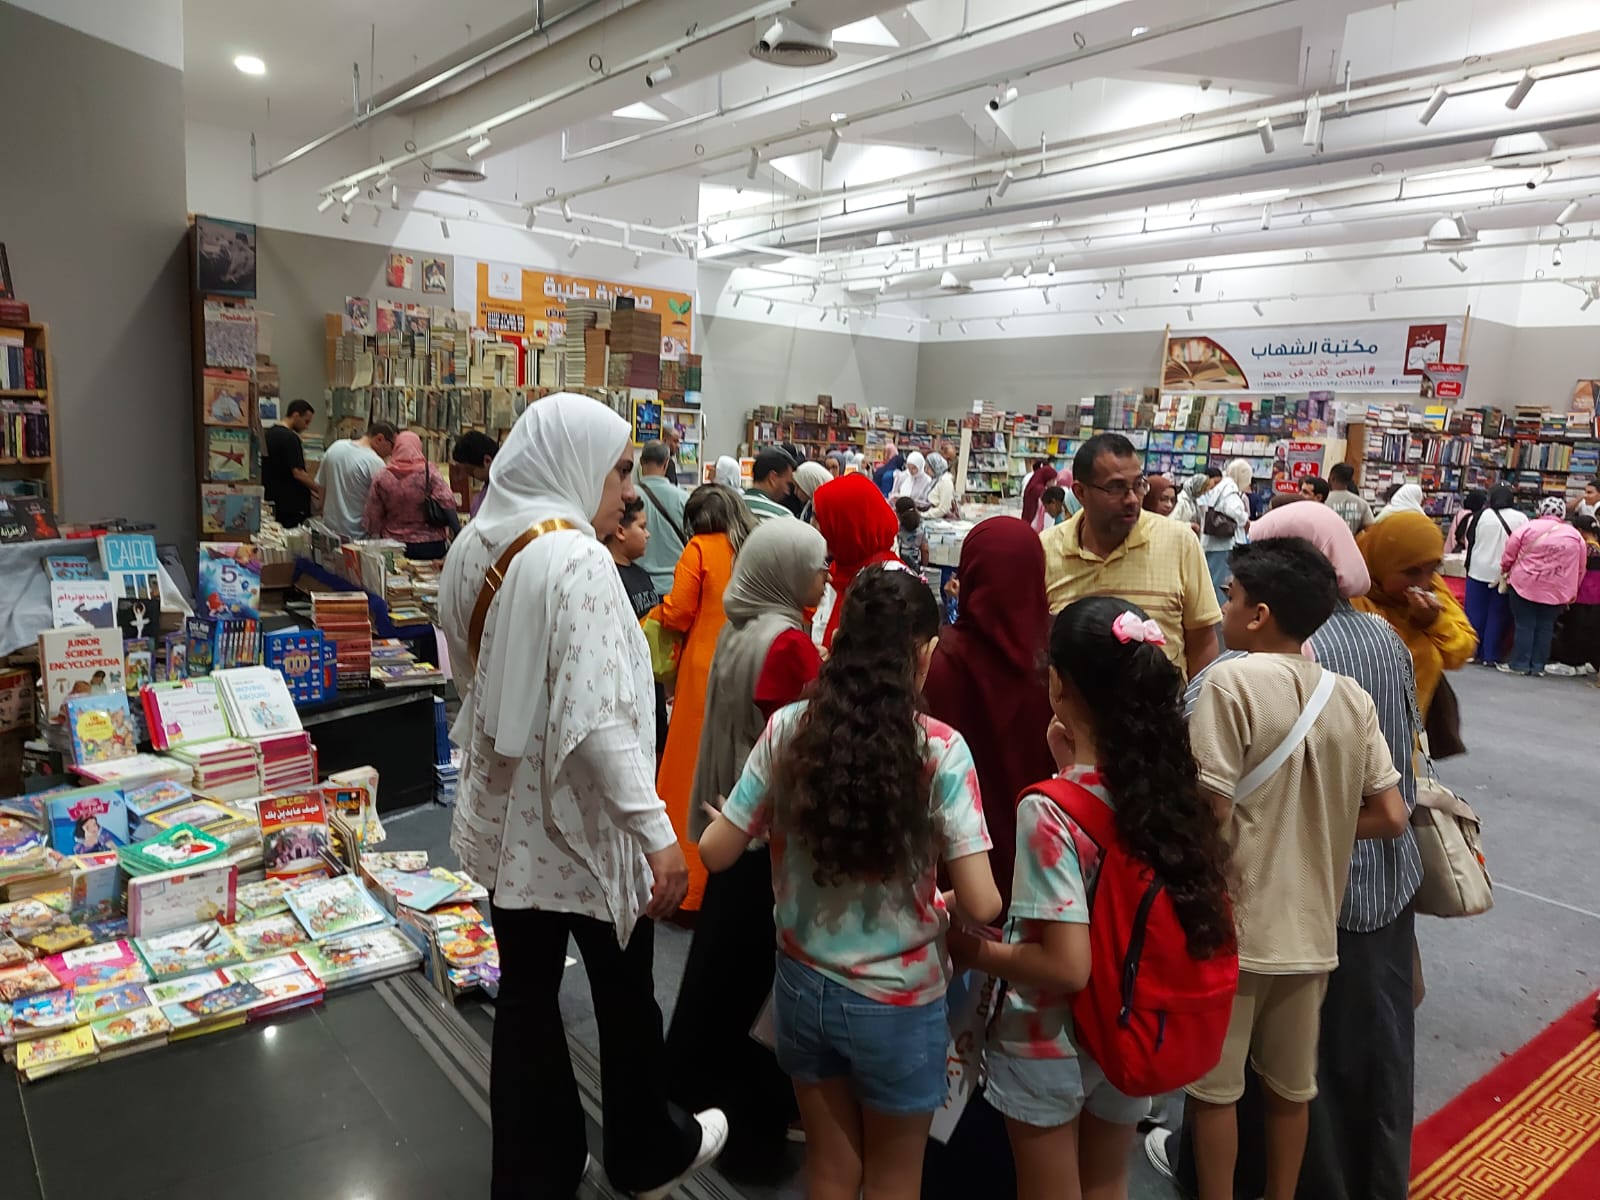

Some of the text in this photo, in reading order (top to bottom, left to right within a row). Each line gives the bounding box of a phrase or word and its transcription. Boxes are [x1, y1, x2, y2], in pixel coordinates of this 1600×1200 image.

[1251, 338, 1378, 360] مكتبة الشهاب
[1300, 463, 1312, 472] 20
[106, 540, 157, 568] CAIRO
[67, 636, 101, 649] JUNIOR
[64, 647, 103, 659] SCIENCE
[48, 657, 121, 671] ENCYCLOPEDIA
[282, 654, 311, 674] 1000
